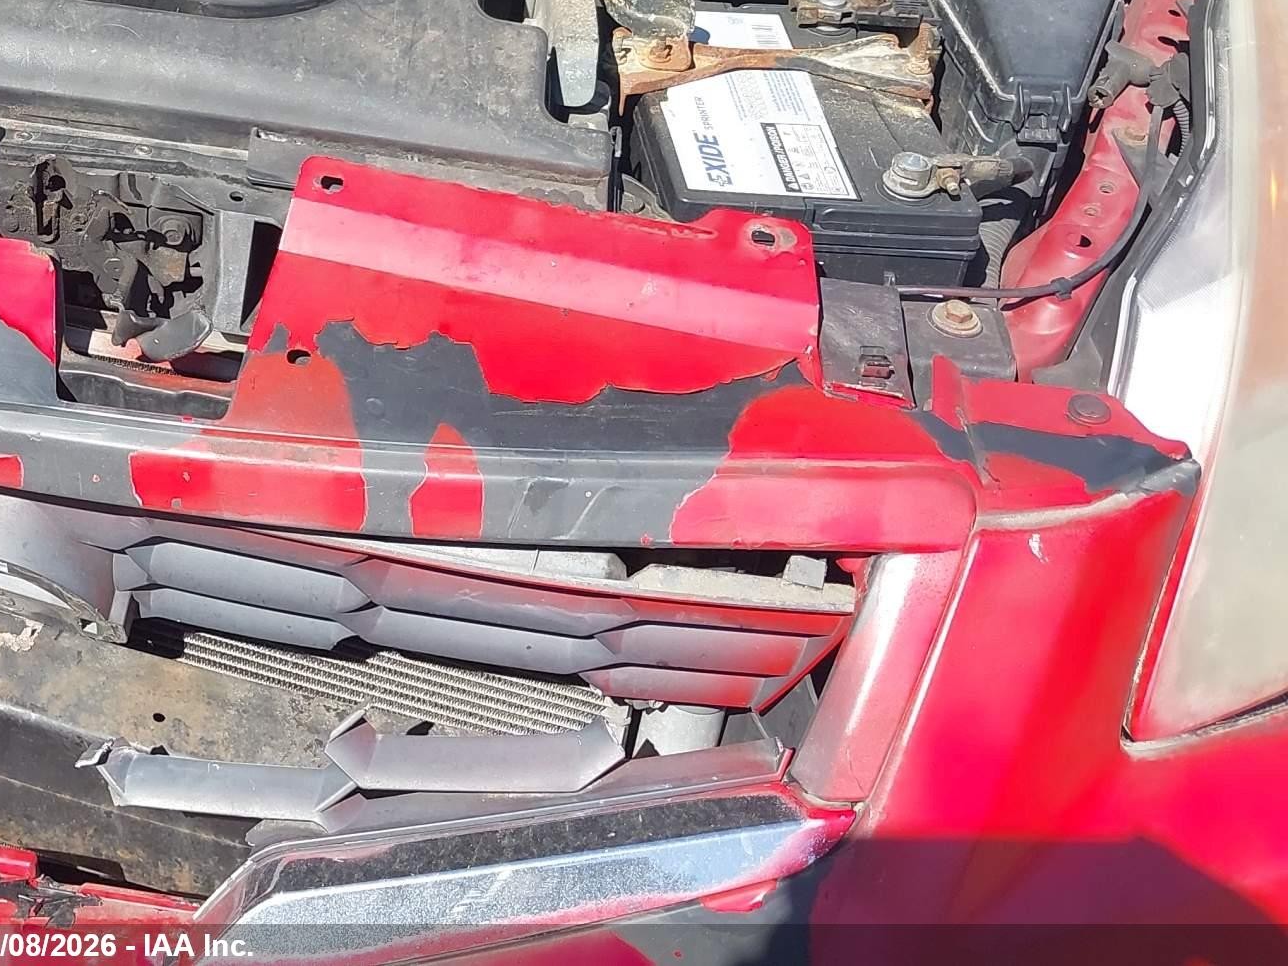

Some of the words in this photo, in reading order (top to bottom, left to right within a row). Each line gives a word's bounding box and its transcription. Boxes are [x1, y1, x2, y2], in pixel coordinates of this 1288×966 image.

[694, 95, 714, 130] SPRINTER
[693, 131, 733, 187] EXIDE
[775, 153, 796, 183] DANGER
